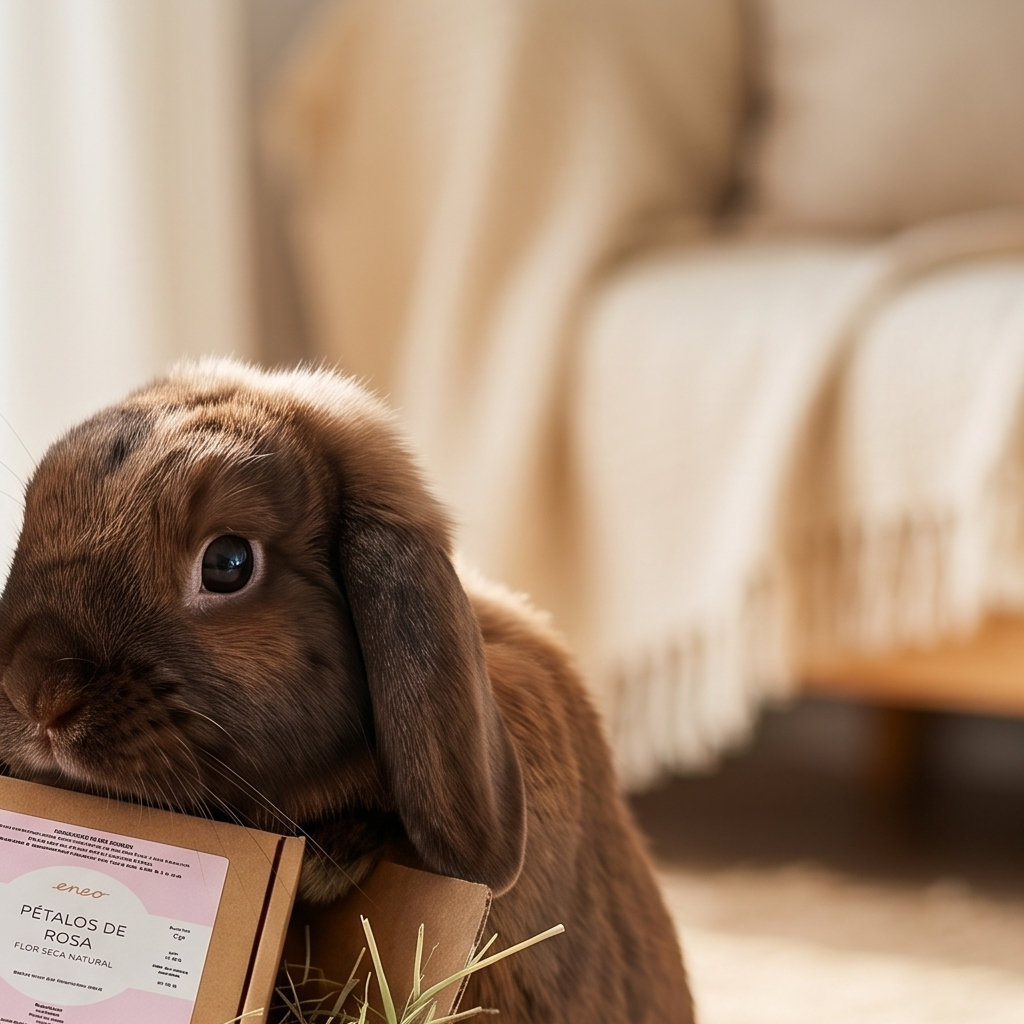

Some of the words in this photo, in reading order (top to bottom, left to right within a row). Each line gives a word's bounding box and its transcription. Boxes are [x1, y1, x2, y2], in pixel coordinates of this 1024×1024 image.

[52, 883, 109, 898] eneo
[21, 905, 98, 931] PÉTALOS
[103, 922, 127, 937] DE
[44, 929, 91, 949] ROSA
[14, 942, 39, 952] FLOR
[42, 948, 65, 958] SECA
[69, 954, 112, 968] NATURAL
